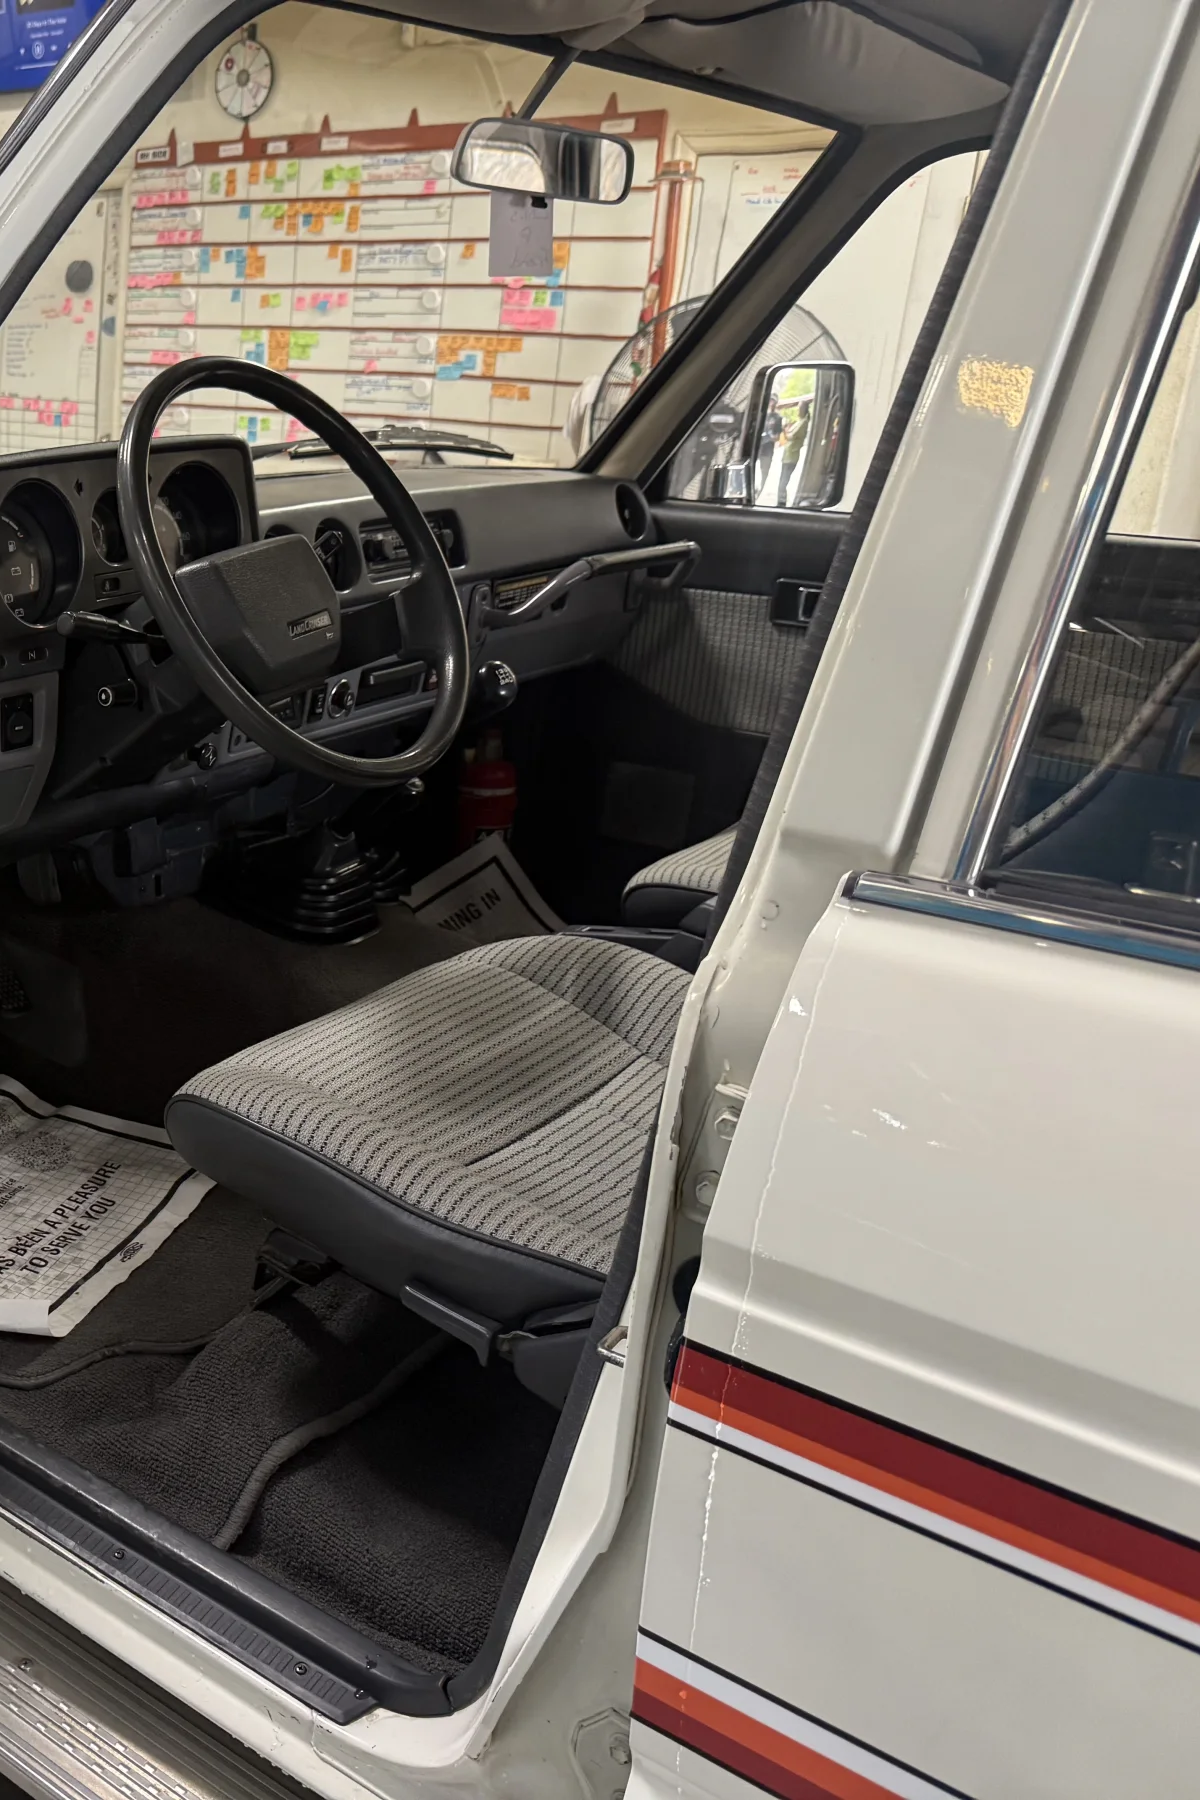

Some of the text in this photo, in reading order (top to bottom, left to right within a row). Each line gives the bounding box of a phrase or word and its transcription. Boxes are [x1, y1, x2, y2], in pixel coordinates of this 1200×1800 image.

[480, 888, 501, 910] IN
[52, 1161, 122, 1219] PLEASURE
[19, 1197, 116, 1275] TO SERVE YOU
[43, 1219, 63, 1229] A
[7, 1228, 51, 1257] BEEN
